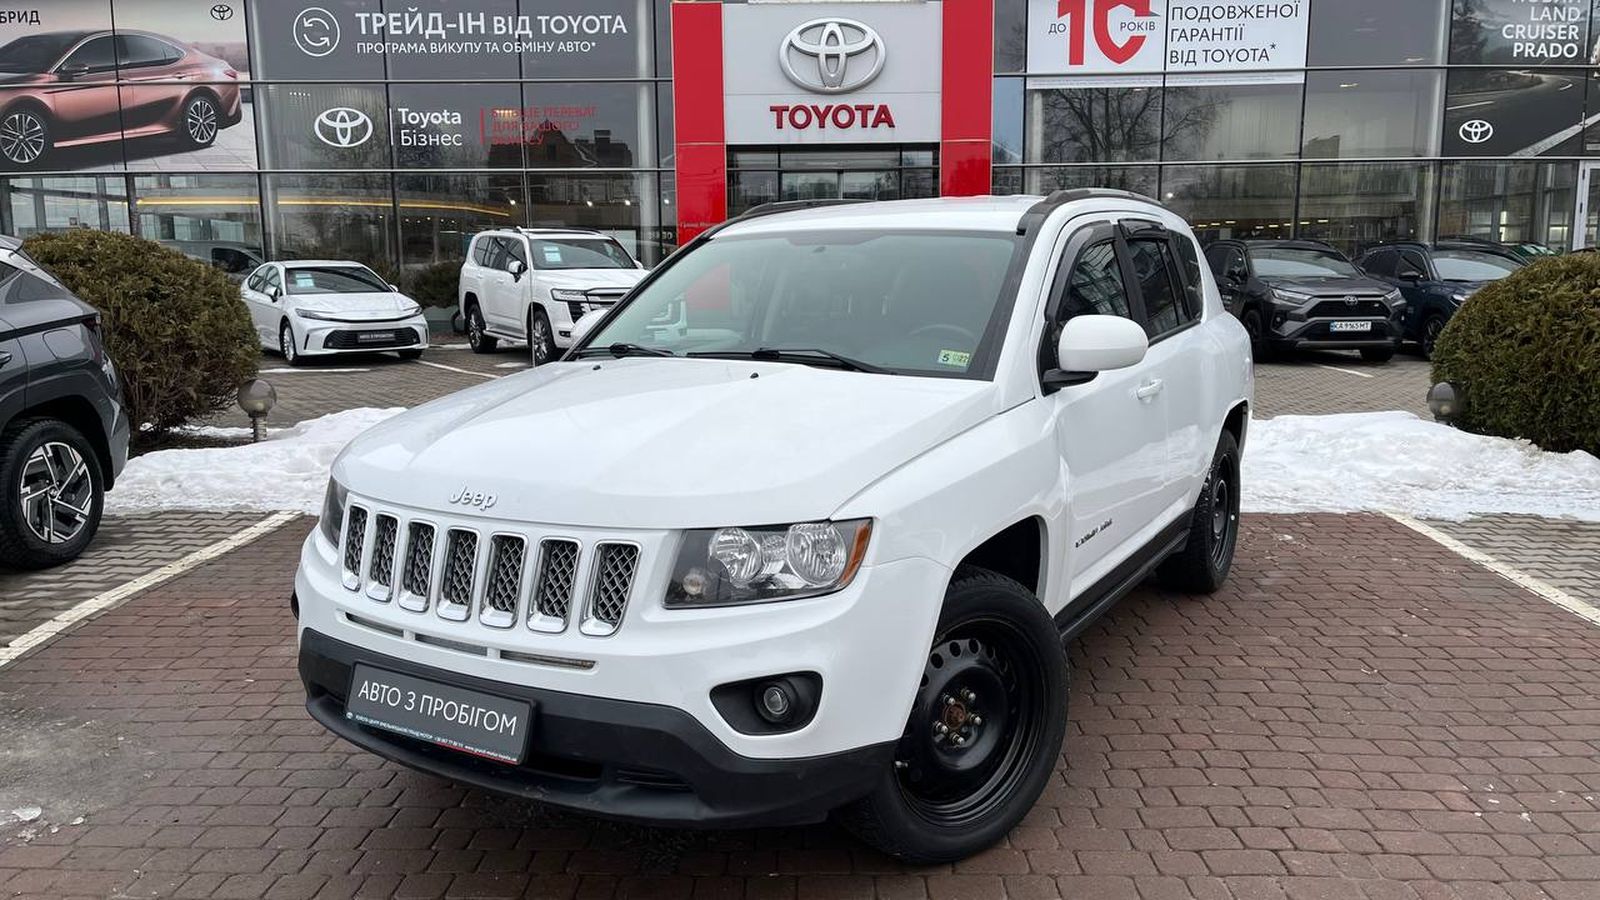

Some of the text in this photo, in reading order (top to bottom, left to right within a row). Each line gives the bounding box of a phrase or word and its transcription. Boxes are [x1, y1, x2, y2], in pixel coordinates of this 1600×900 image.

[1171, 0, 1300, 23] ПОДОВЖЕНОЇ
[1530, 6, 1581, 22] LAND
[355, 7, 628, 40] ТРЕЙД-ІН ВІД TOYOTA
[1048, 23, 1067, 35] ДО
[1120, 21, 1156, 32] РОКІВ
[1170, 23, 1246, 42] ГАРАНТІЇ
[1502, 24, 1579, 40] CRUISER
[356, 42, 427, 54] ПРОГРАМА
[430, 42, 482, 53] ВИКУПУ
[484, 42, 500, 53] ТА
[502, 41, 555, 53] ОБМІНУ
[1513, 42, 1578, 58] PRADO
[1169, 50, 1197, 67] ВІД
[397, 108, 462, 128] Toyota
[770, 104, 896, 130] TOYOTA
[400, 129, 463, 147] Бізнес
[449, 483, 498, 512] Jeep
[358, 680, 402, 707] АВТО
[419, 695, 518, 737] ПРОБІГОМ
